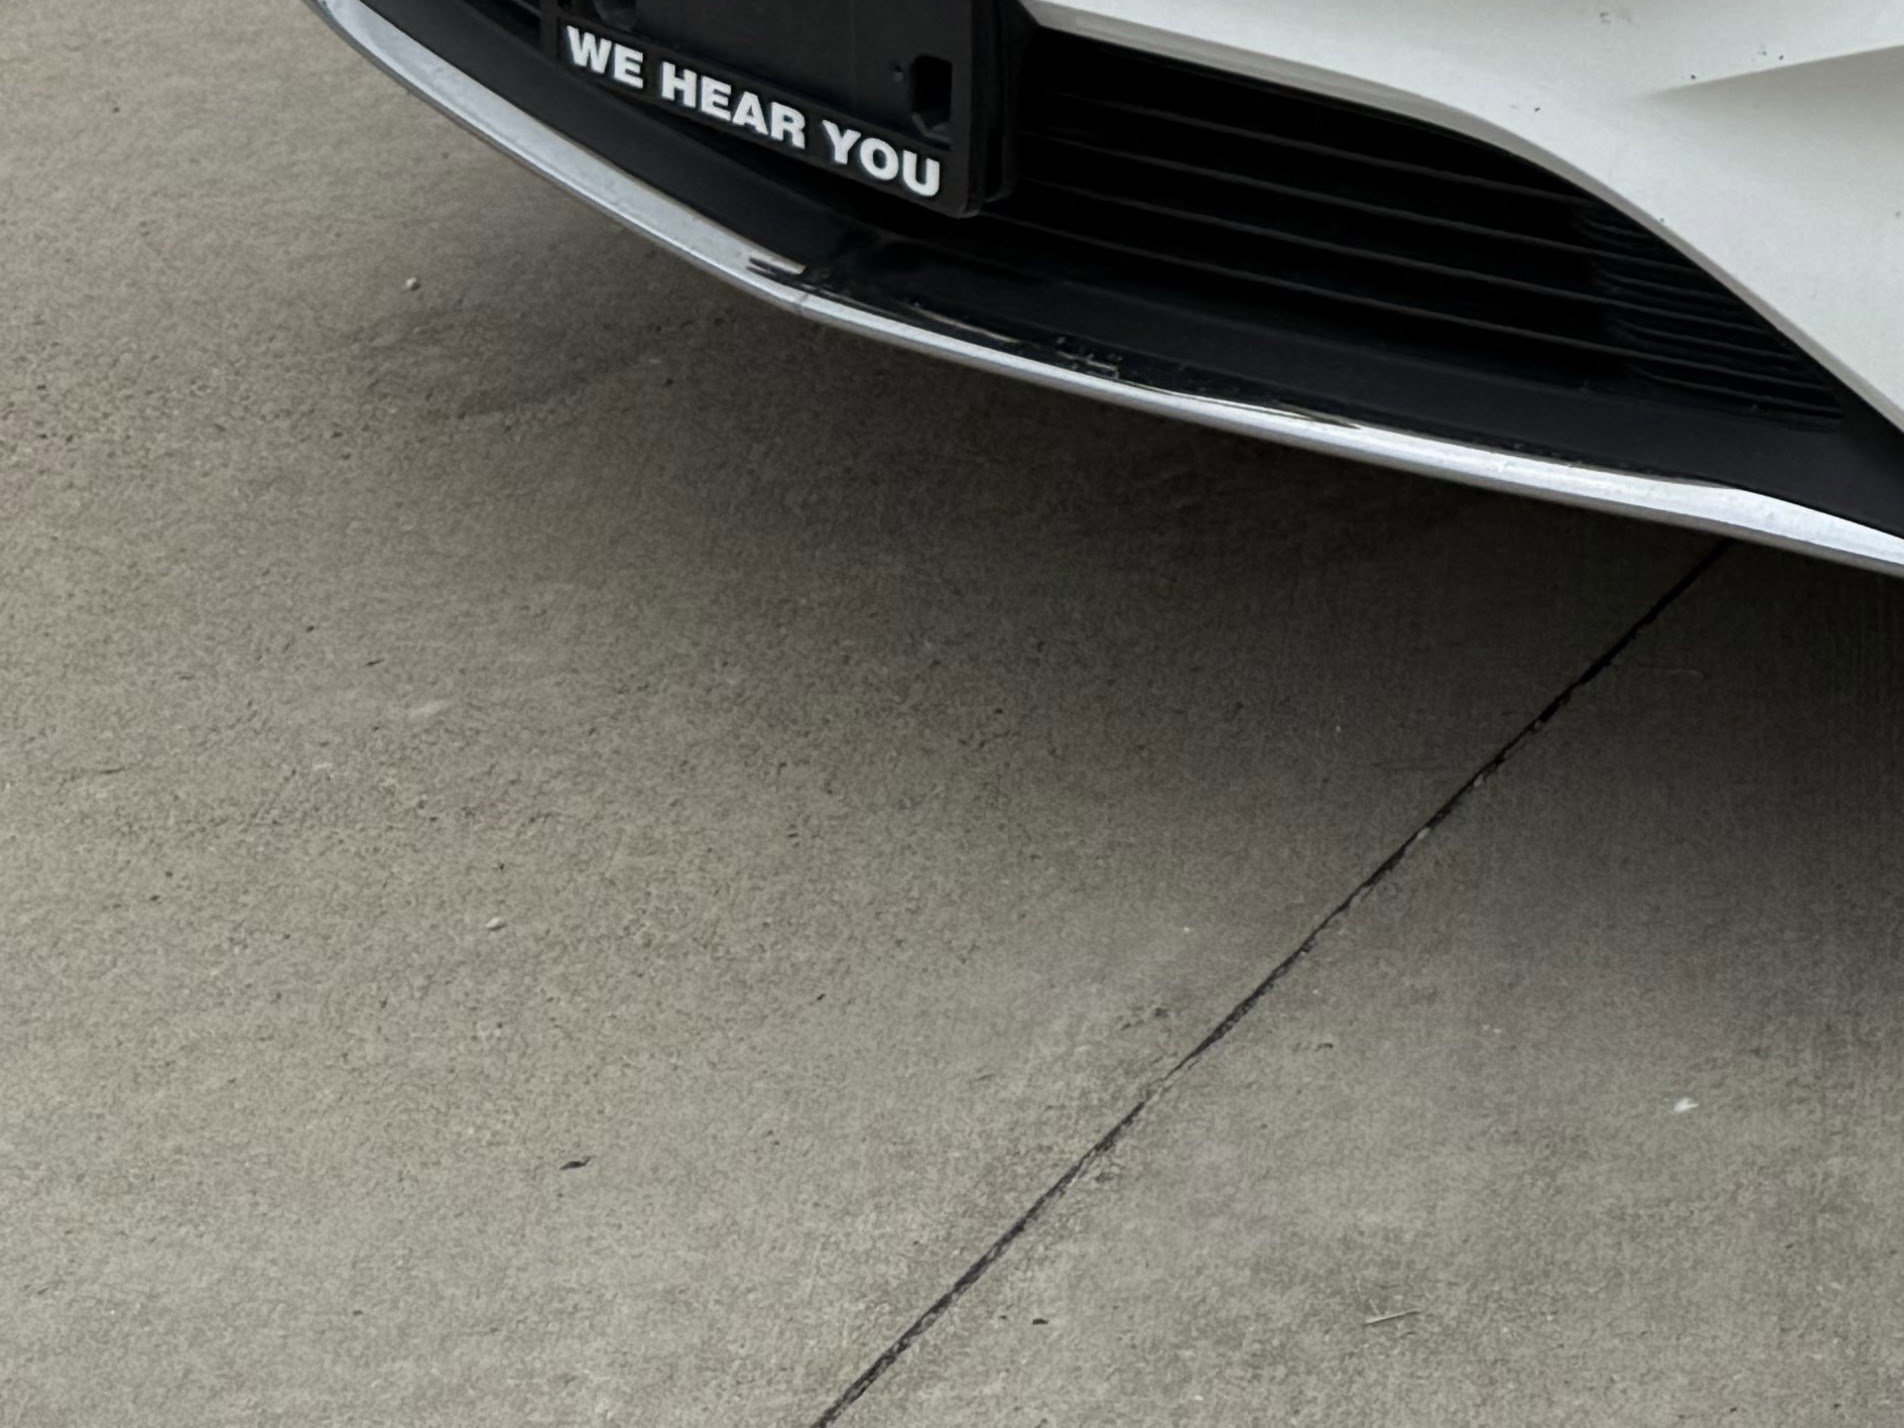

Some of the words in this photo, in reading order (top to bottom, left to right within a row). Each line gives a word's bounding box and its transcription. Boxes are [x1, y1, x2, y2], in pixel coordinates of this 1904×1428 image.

[567, 25, 644, 89] WE
[661, 61, 806, 149] HEAR
[823, 120, 941, 198] YOU
